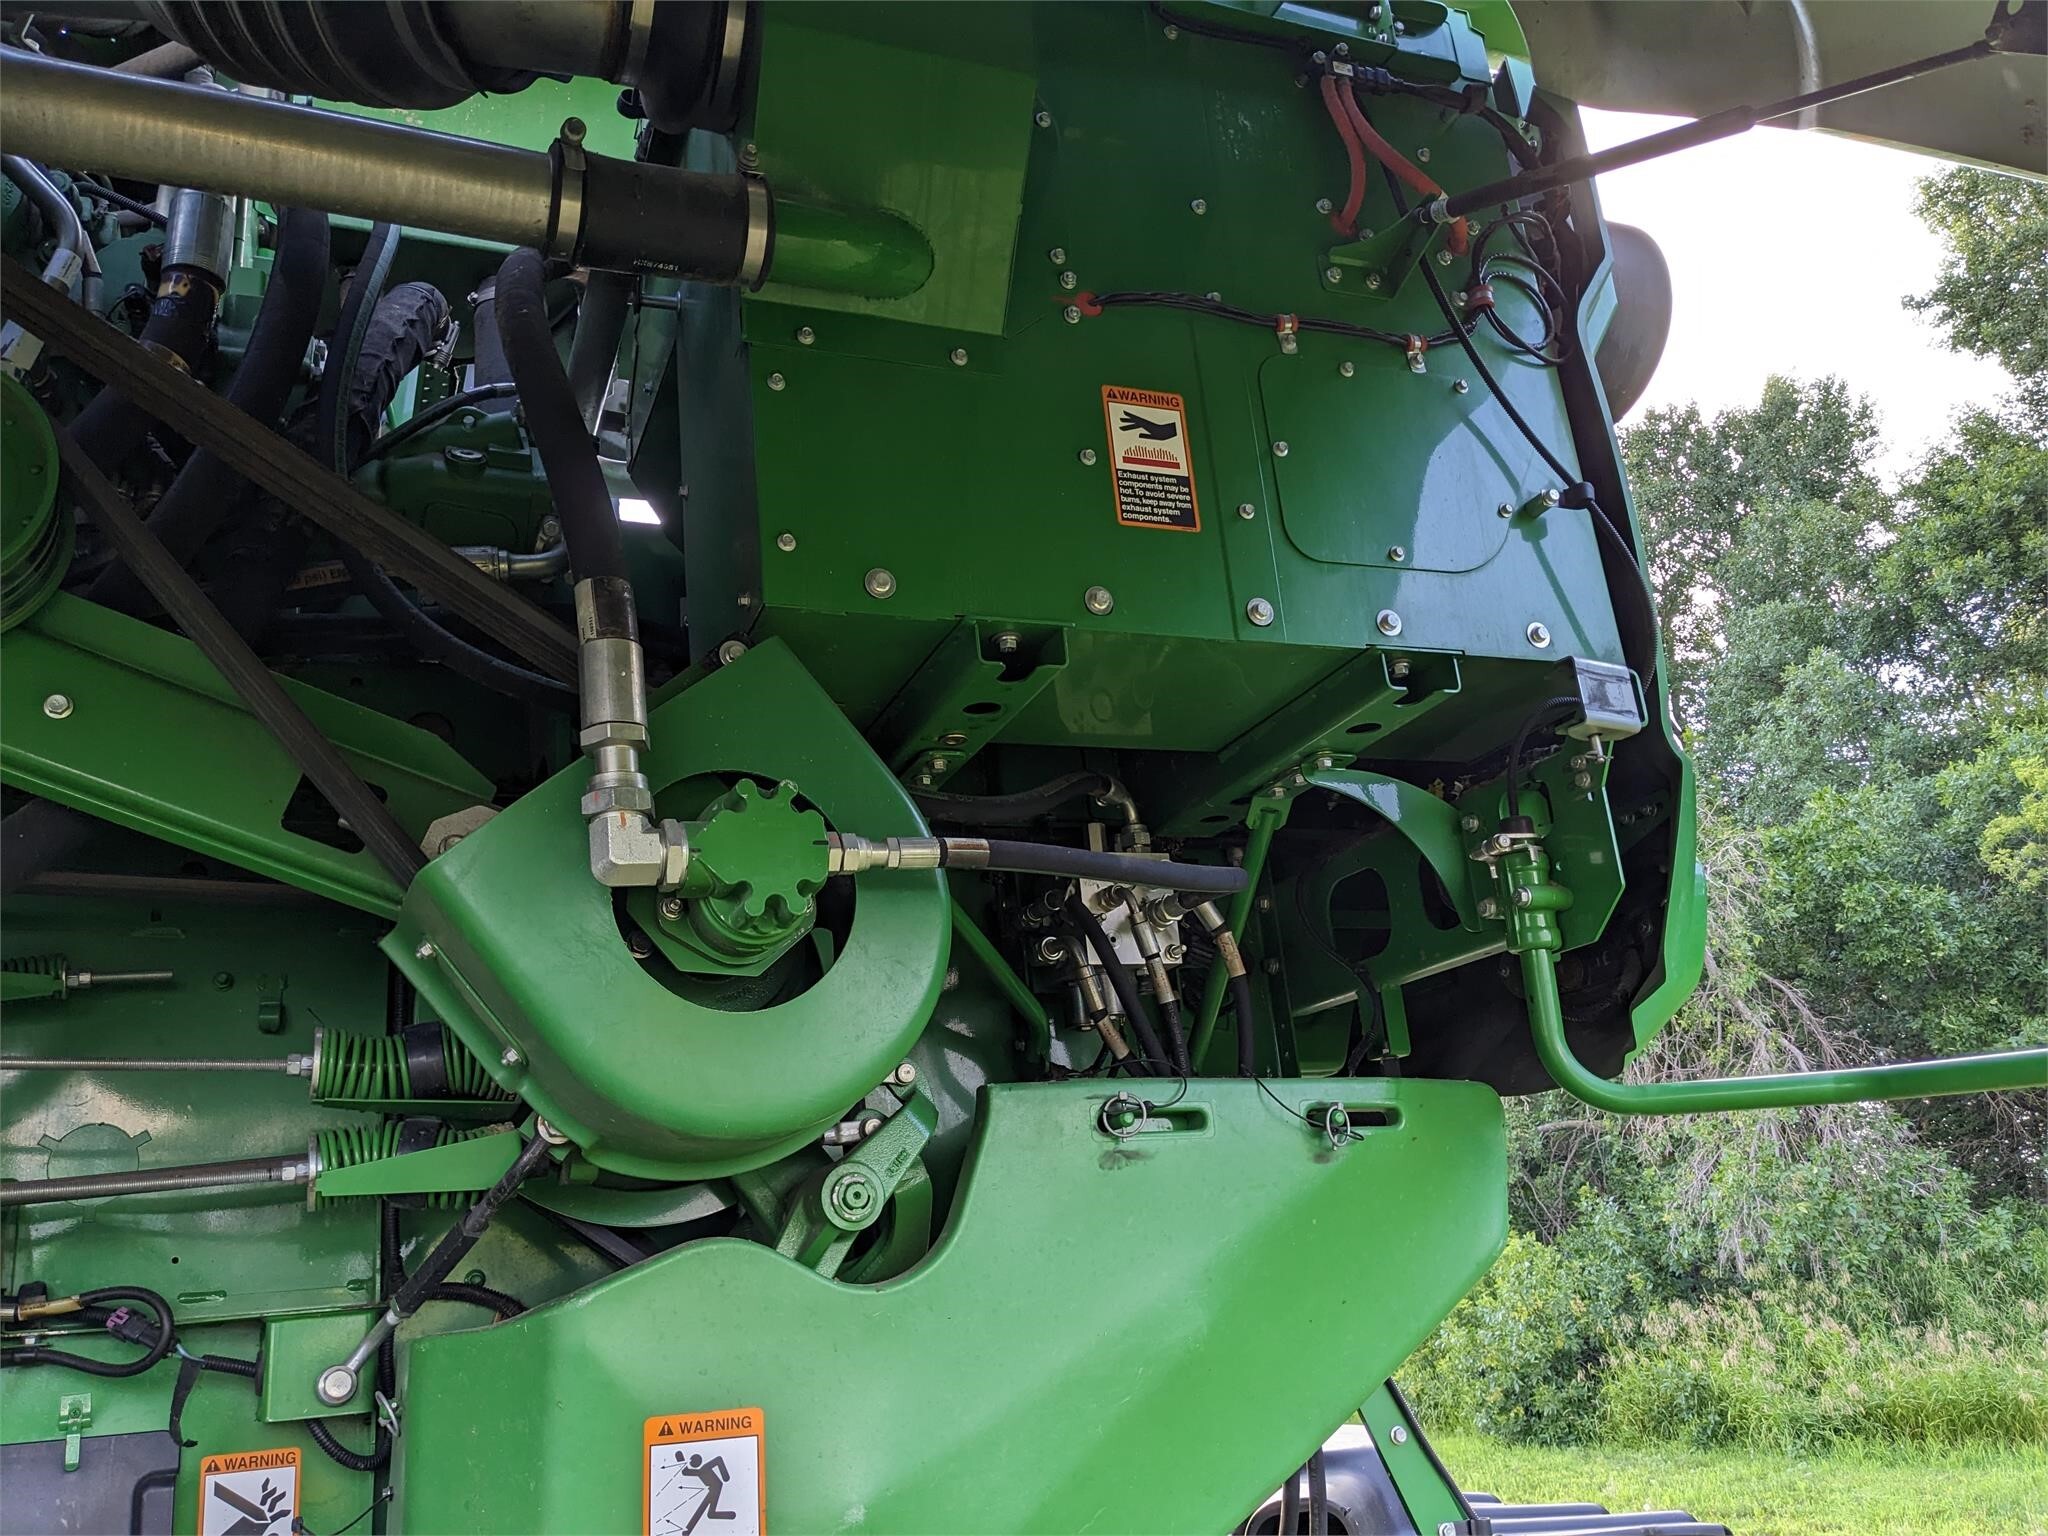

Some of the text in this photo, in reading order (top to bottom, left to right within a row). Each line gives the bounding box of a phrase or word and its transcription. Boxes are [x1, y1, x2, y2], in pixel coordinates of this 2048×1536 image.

[1118, 390, 1180, 408] WARNING
[1118, 471, 1177, 484] Exhaust system
[1118, 480, 1162, 490] components
[1164, 485, 1178, 493] may
[1120, 487, 1191, 501] hot. To avoid severe
[1121, 495, 1192, 509] burns, keep away from
[1122, 504, 1180, 516] exhaust system
[1123, 512, 1172, 523] components.
[679, 1416, 752, 1434] WARNING
[224, 1451, 297, 1471] WARNING
